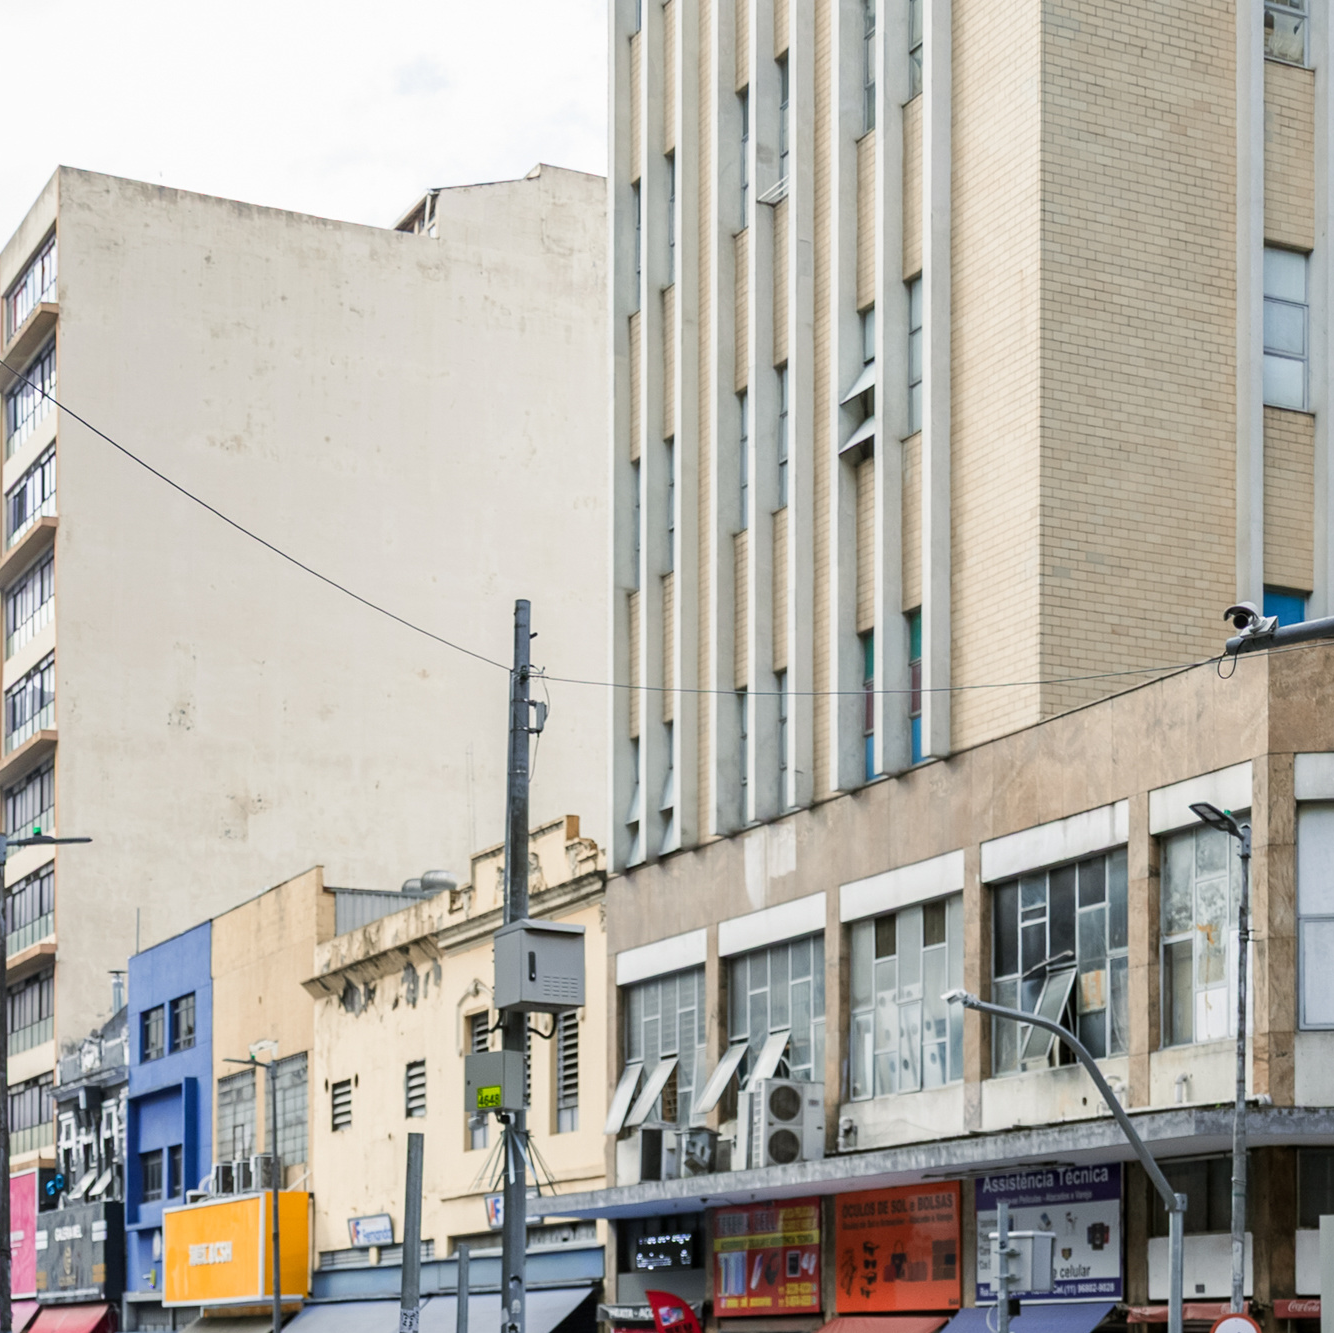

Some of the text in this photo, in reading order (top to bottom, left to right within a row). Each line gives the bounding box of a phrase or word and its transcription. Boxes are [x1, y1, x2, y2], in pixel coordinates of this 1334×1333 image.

[982, 1165, 1109, 1193] Assistência Técnica
[877, 1199, 888, 1215] DE
[891, 1198, 907, 1214] SOL
[917, 1193, 953, 1211] BOLSAS
[1060, 1263, 1090, 1279] celular
